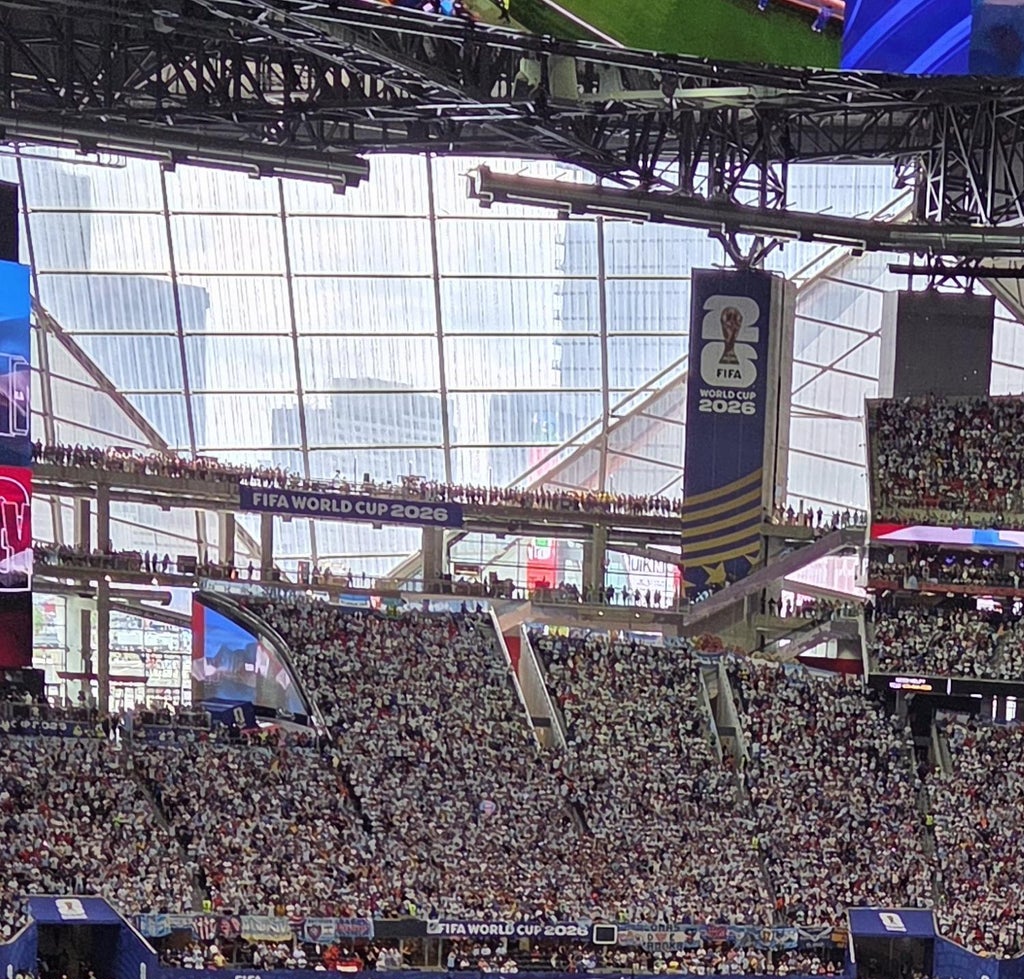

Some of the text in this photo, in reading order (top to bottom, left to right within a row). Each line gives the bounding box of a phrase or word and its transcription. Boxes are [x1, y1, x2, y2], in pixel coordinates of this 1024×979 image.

[716, 368, 742, 379] FIFA
[700, 389, 757, 399] WORLD CUP
[699, 399, 756, 415] 2026
[253, 492, 448, 522] FIFA WORLD CUP 2026
[439, 923, 589, 937] FIFA WORLD CUP 2026
